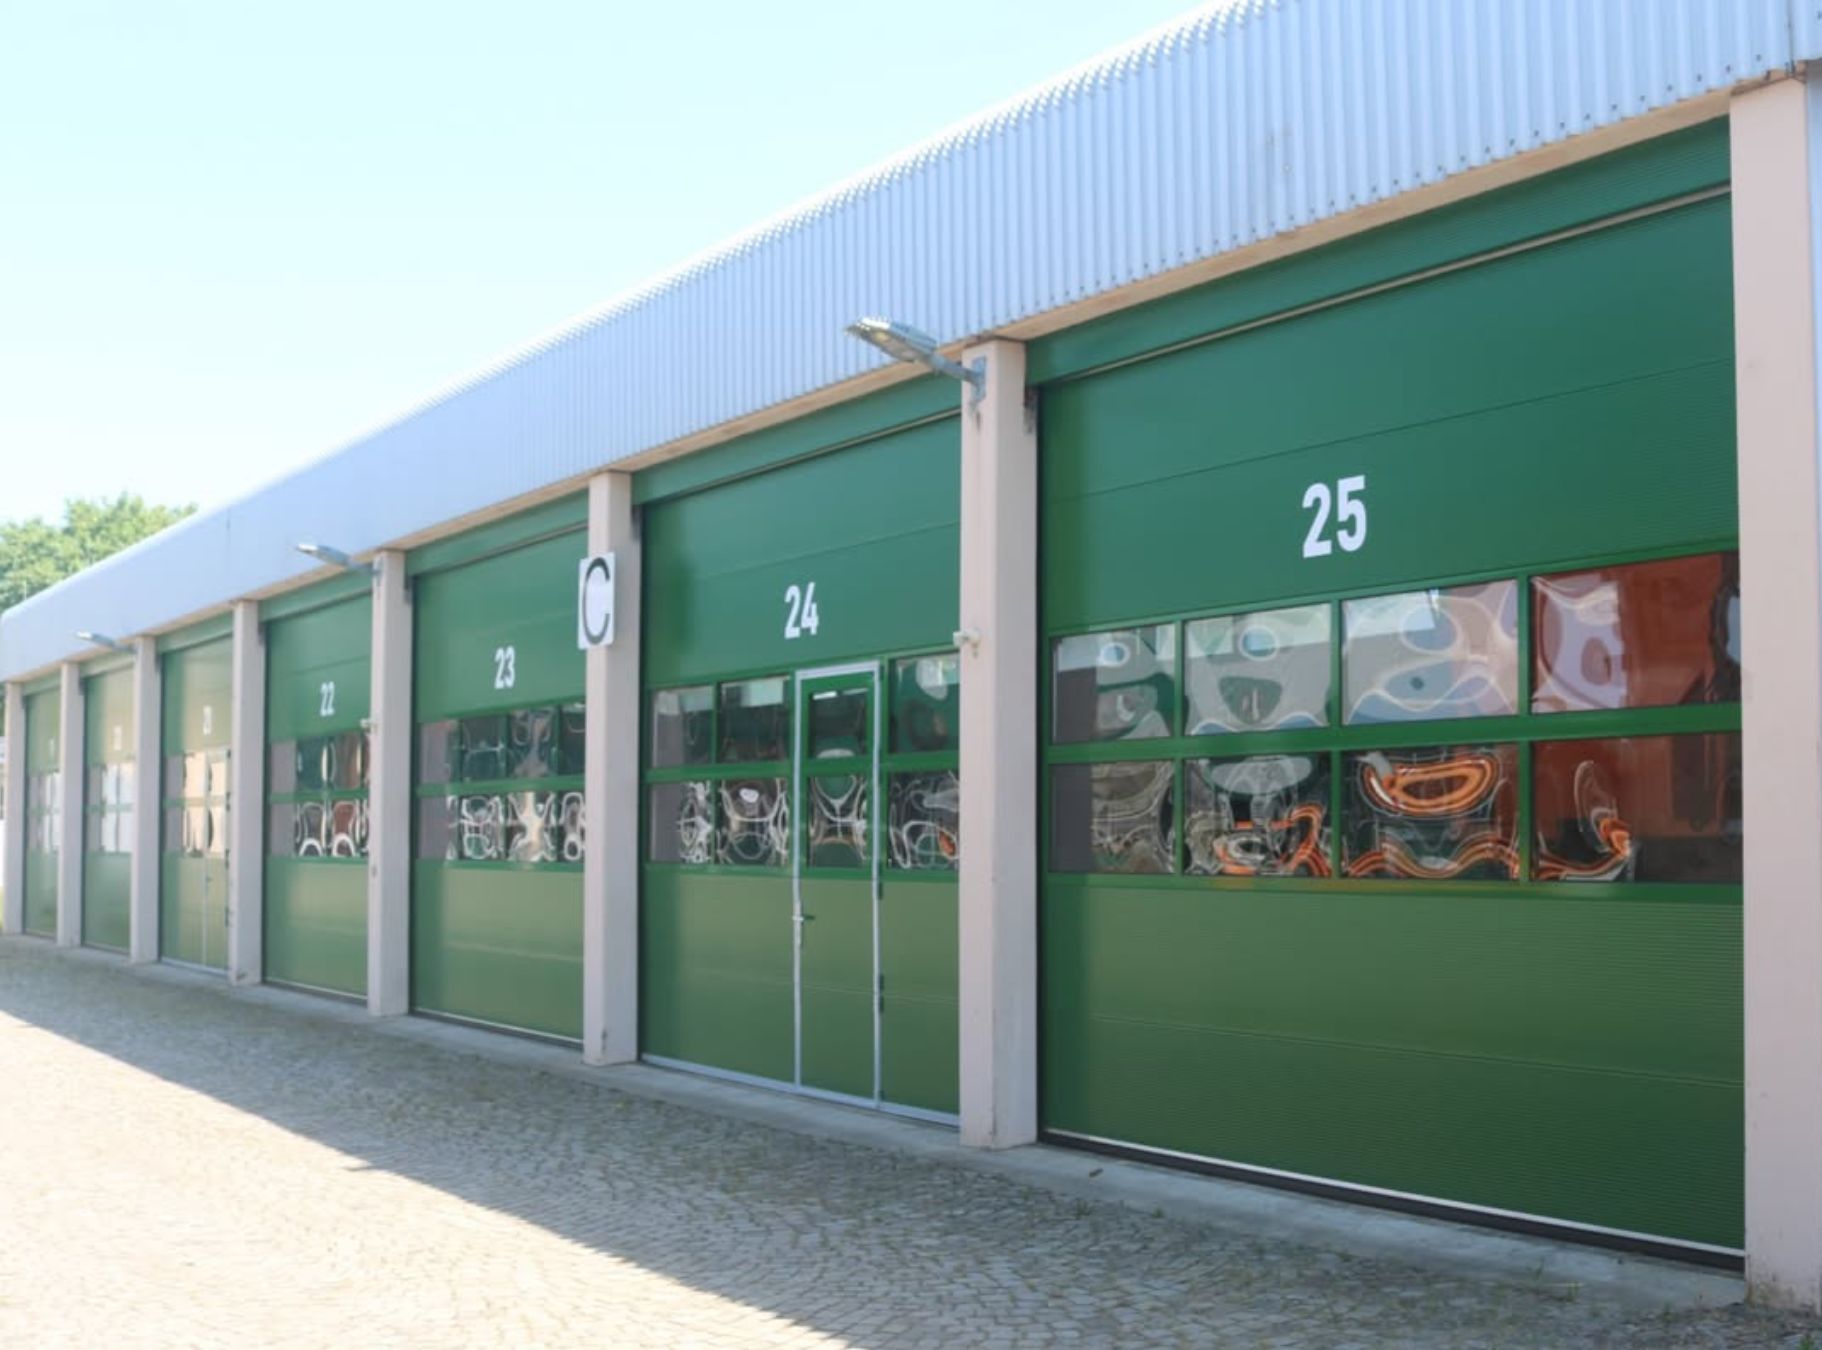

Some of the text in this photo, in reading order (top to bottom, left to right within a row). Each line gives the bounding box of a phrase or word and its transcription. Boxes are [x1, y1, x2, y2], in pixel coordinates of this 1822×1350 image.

[1302, 475, 1366, 558] 25
[582, 557, 610, 645] C
[784, 581, 819, 639] 24
[494, 646, 515, 689] 23
[320, 681, 335, 716] 22
